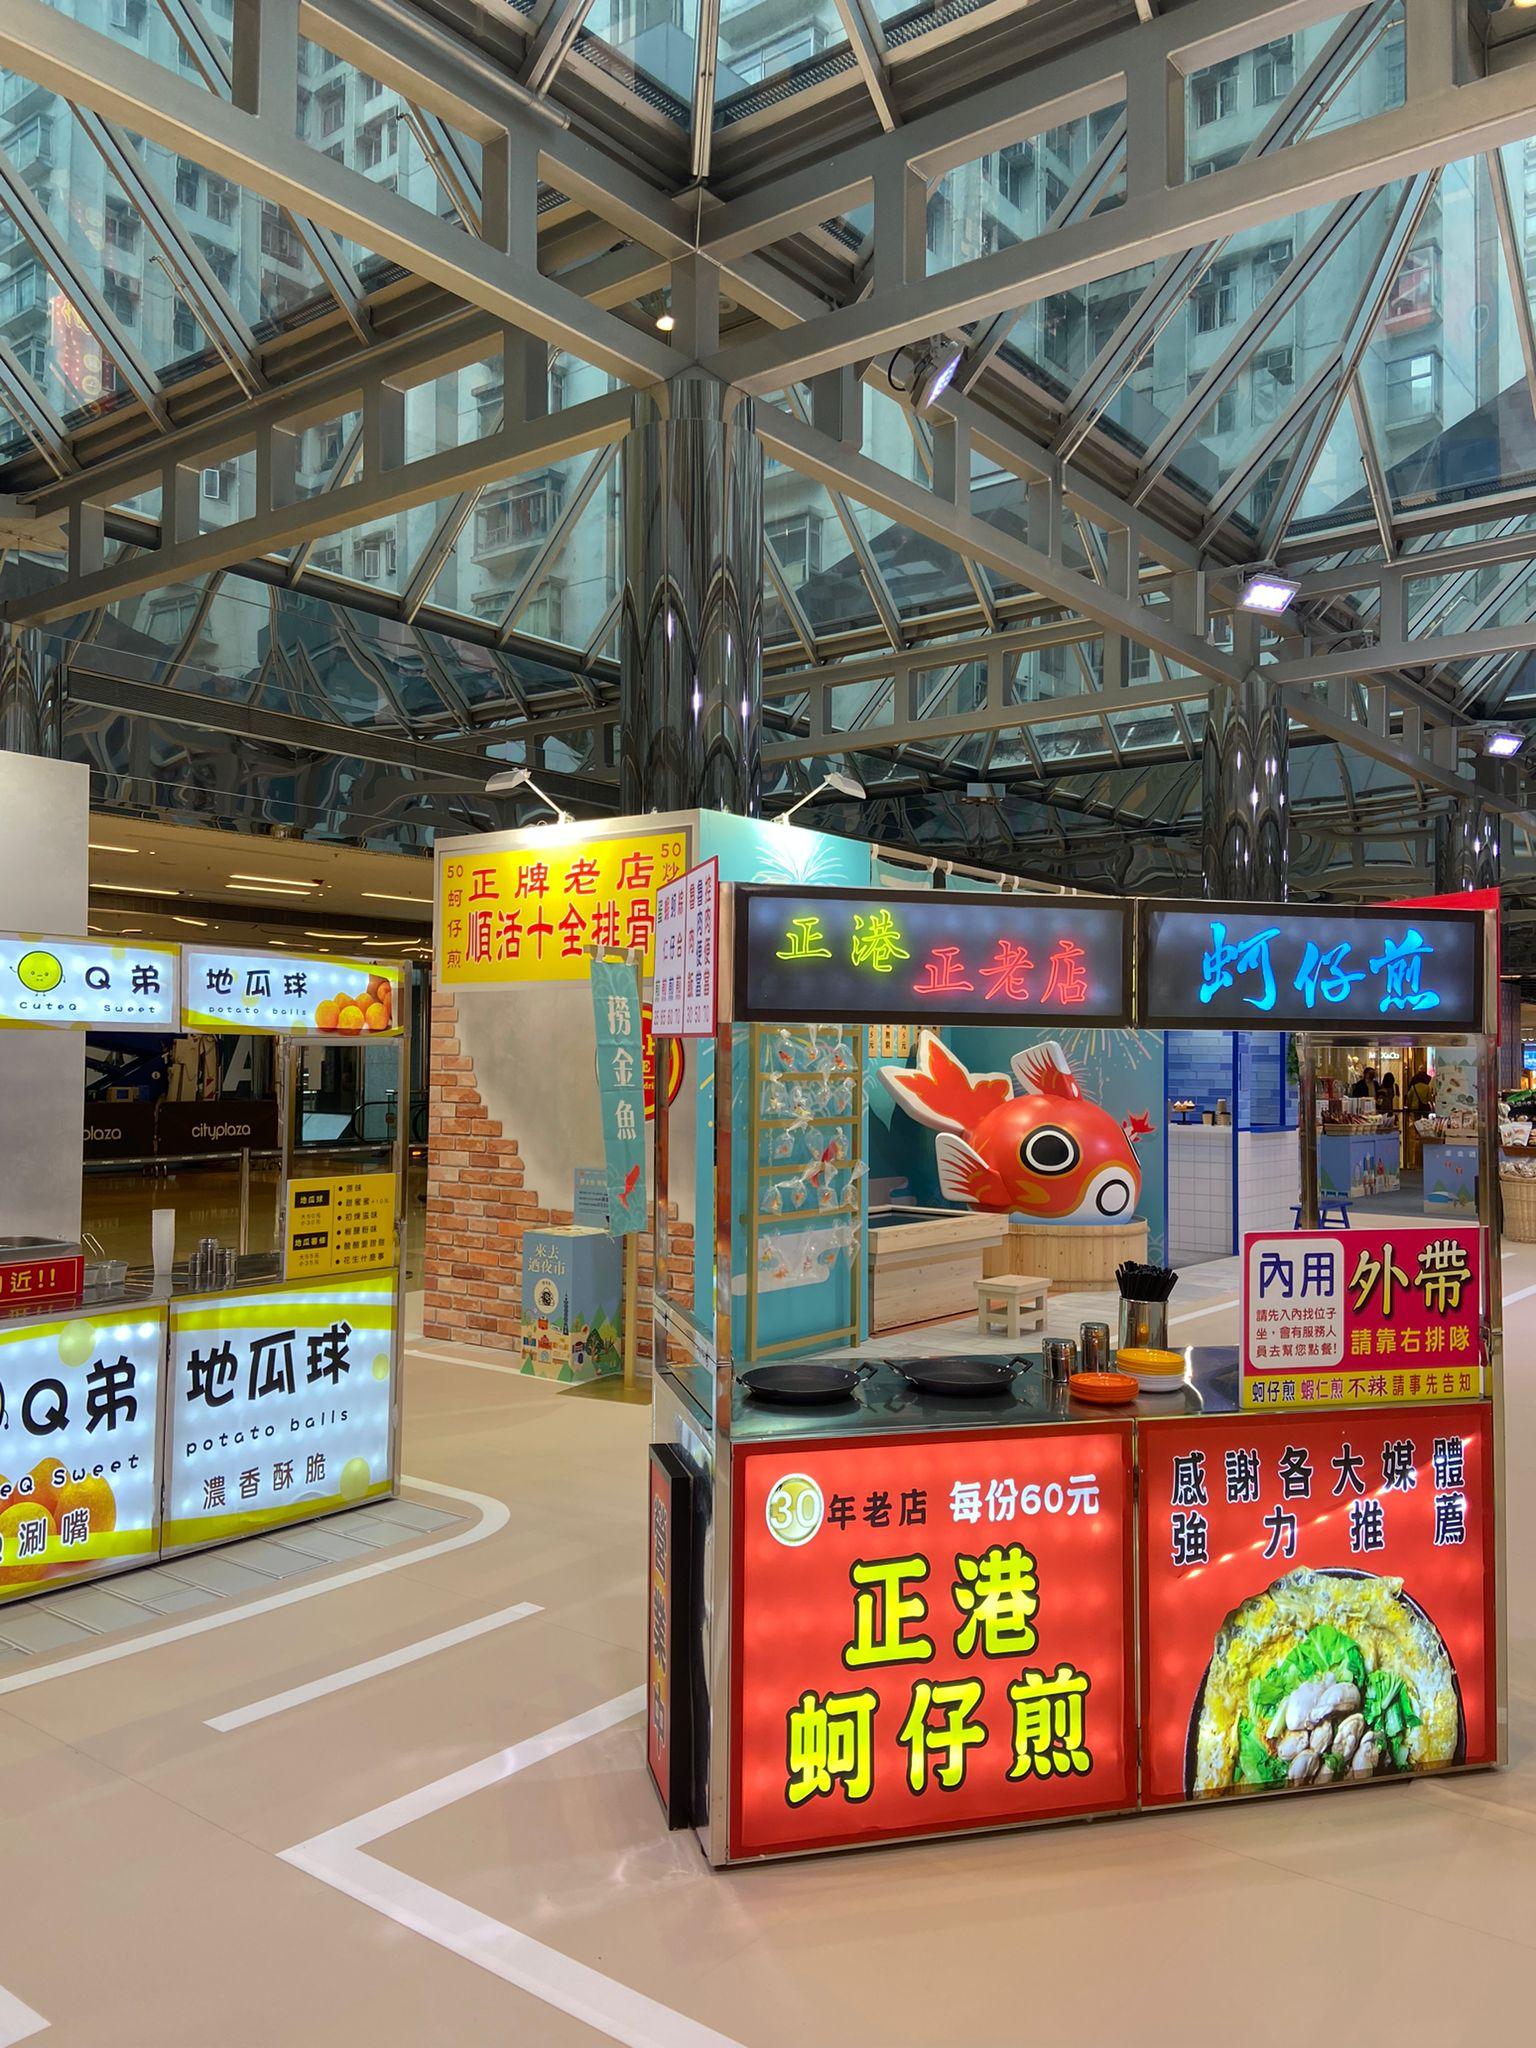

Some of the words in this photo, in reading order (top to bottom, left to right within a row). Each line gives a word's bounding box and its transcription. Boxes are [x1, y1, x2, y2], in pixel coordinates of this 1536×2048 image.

[467, 852, 655, 902] 正牌老店
[447, 889, 462, 968] 蚵仔煎
[465, 899, 656, 965] 順活十全排骨
[776, 910, 910, 976] 正港
[84, 964, 161, 996] Q弟
[206, 967, 308, 999] 地瓜球
[912, 938, 1089, 1006] 正老店
[1198, 921, 1441, 1014] 蚵仔煎
[19, 1001, 79, 1012] CuteQ
[103, 1003, 157, 1015] Sweet
[208, 1005, 261, 1016] potato
[272, 1006, 308, 1016] balls
[605, 995, 637, 1141] 撈金魚
[191, 1122, 251, 1141] cityplaza
[0, 1268, 56, 1293] 近!!
[1259, 1252, 1335, 1299] 內用
[1349, 1239, 1471, 1316] 外帶
[1256, 1307, 1337, 1322] 請先入內找位子
[1351, 1325, 1470, 1356] 請靠右排隊
[186, 1320, 353, 1407] 地瓜球
[1252, 1380, 1296, 1403] 蚵仔煎
[1300, 1378, 1344, 1400] 蝦仁煎
[1347, 1375, 1388, 1398] 不辣
[1392, 1372, 1471, 1396] 請事先告知
[20, 1353, 138, 1436] Q弟
[186, 1425, 275, 1457] potato
[290, 1408, 349, 1432] balls
[53, 1454, 139, 1486] Sweet
[203, 1453, 326, 1510] 濃香酥脆
[1171, 1437, 1465, 1507] 感謝各大媒體
[949, 1474, 1101, 1525] 每份60元
[0, 1509, 89, 1562] 涮嘴
[1171, 1492, 1468, 1567] 強力推薦
[842, 1542, 1041, 1671] 正港
[783, 1664, 1094, 1809] 蚵仔煎
